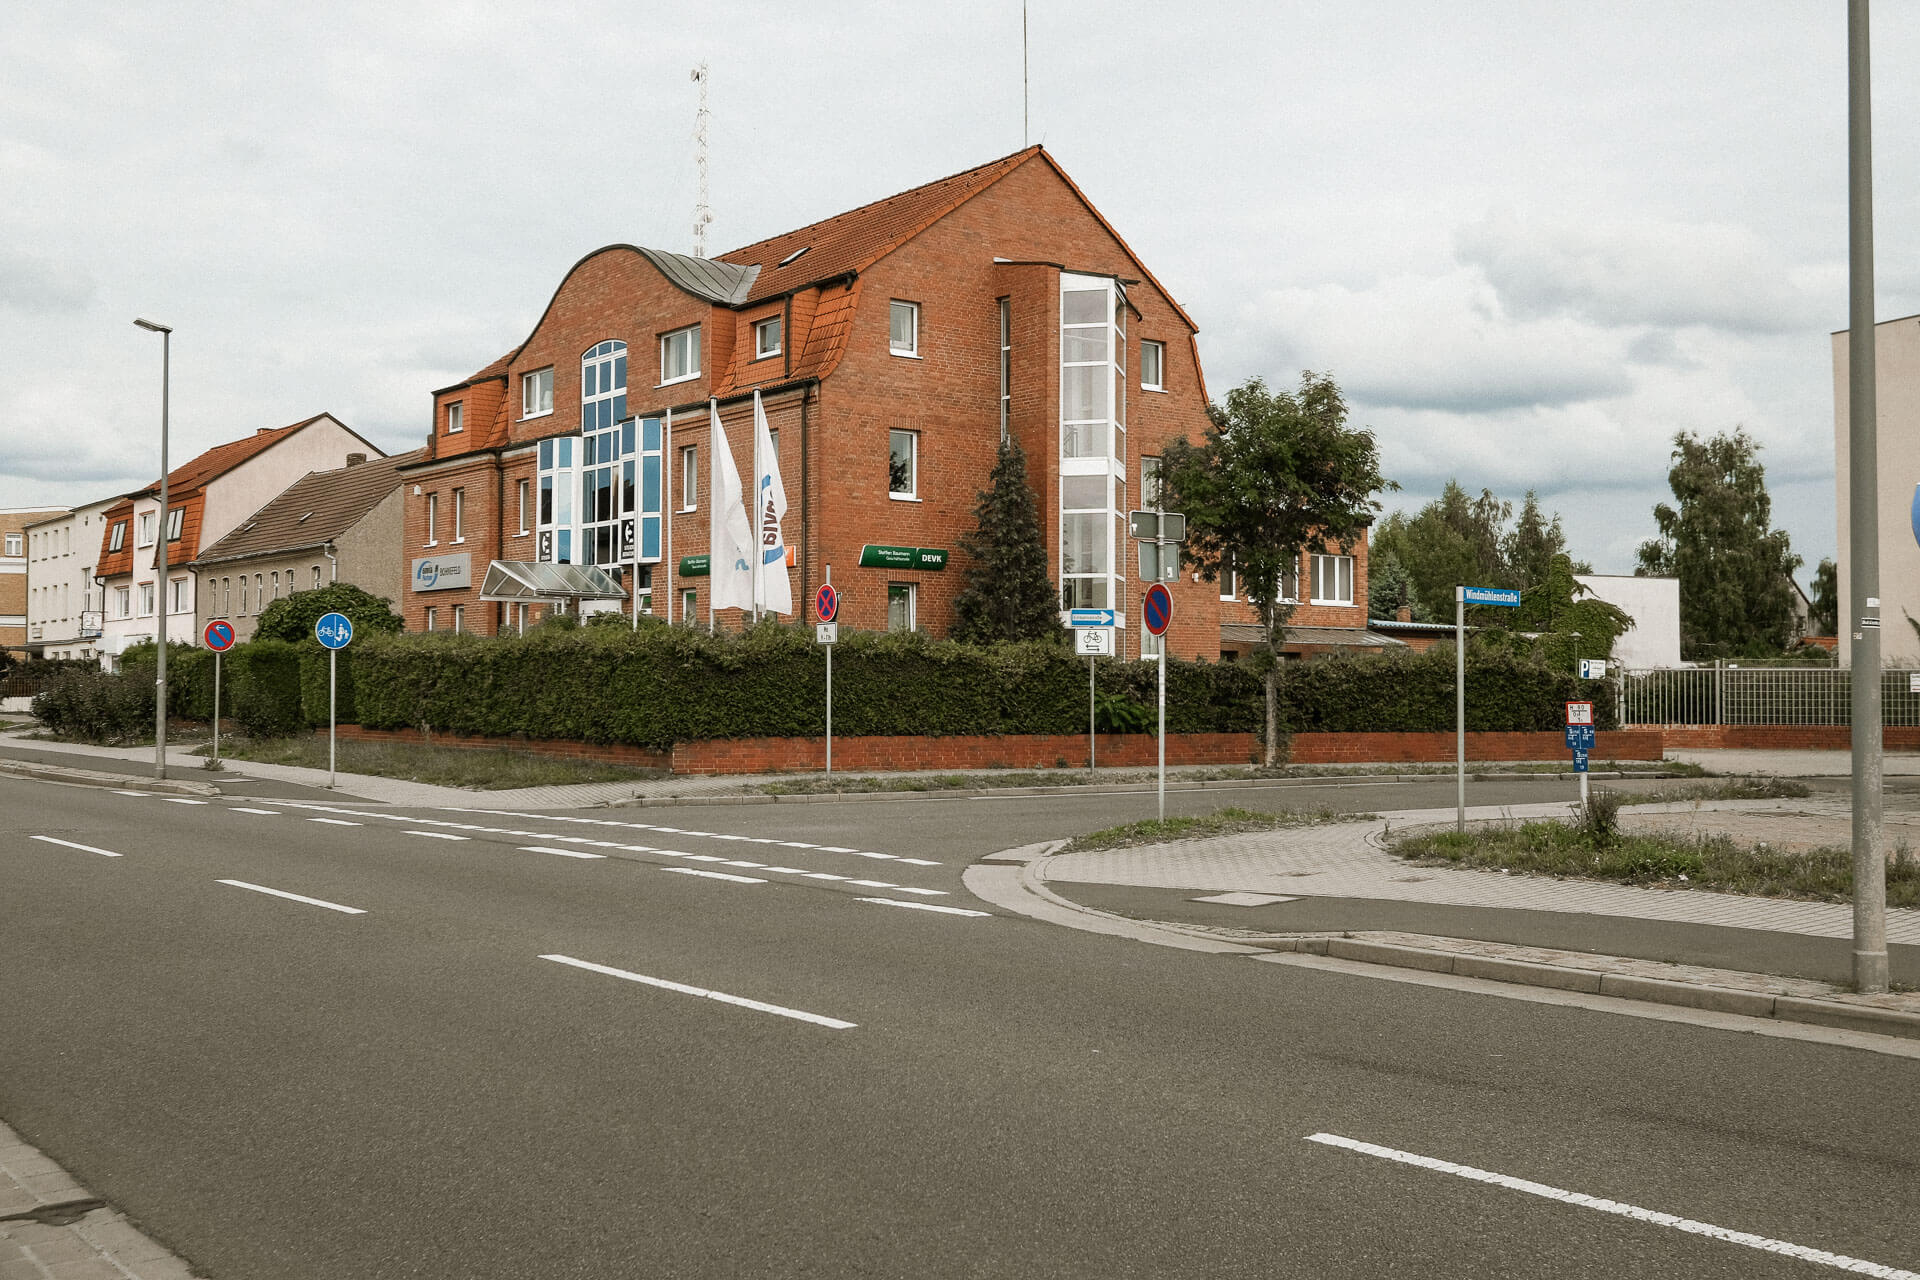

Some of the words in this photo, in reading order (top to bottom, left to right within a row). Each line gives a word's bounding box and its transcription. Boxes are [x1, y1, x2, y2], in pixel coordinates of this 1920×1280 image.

[921, 554, 942, 563] DEVK
[1465, 589, 1518, 603] Windmühlenstraße
[1580, 660, 1589, 678] P
